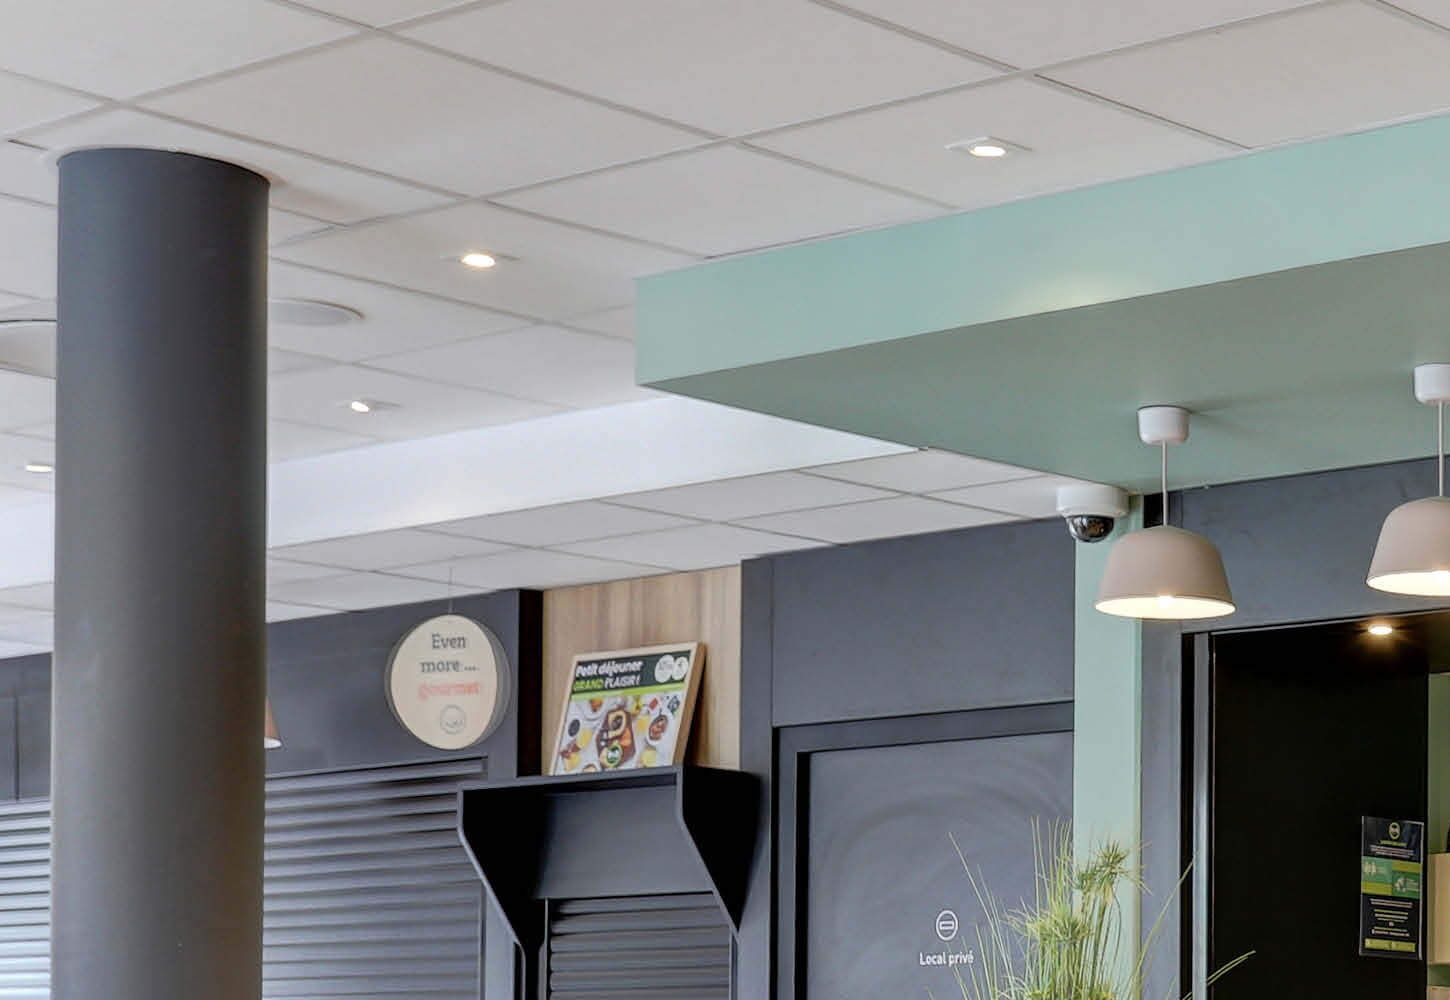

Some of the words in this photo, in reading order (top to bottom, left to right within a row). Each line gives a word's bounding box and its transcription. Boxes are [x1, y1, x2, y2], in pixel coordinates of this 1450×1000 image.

[431, 633, 467, 649] Even
[575, 663, 598, 677] Petit
[598, 661, 643, 677] déjeuner
[920, 951, 946, 965] Local
[948, 950, 974, 967] privé
